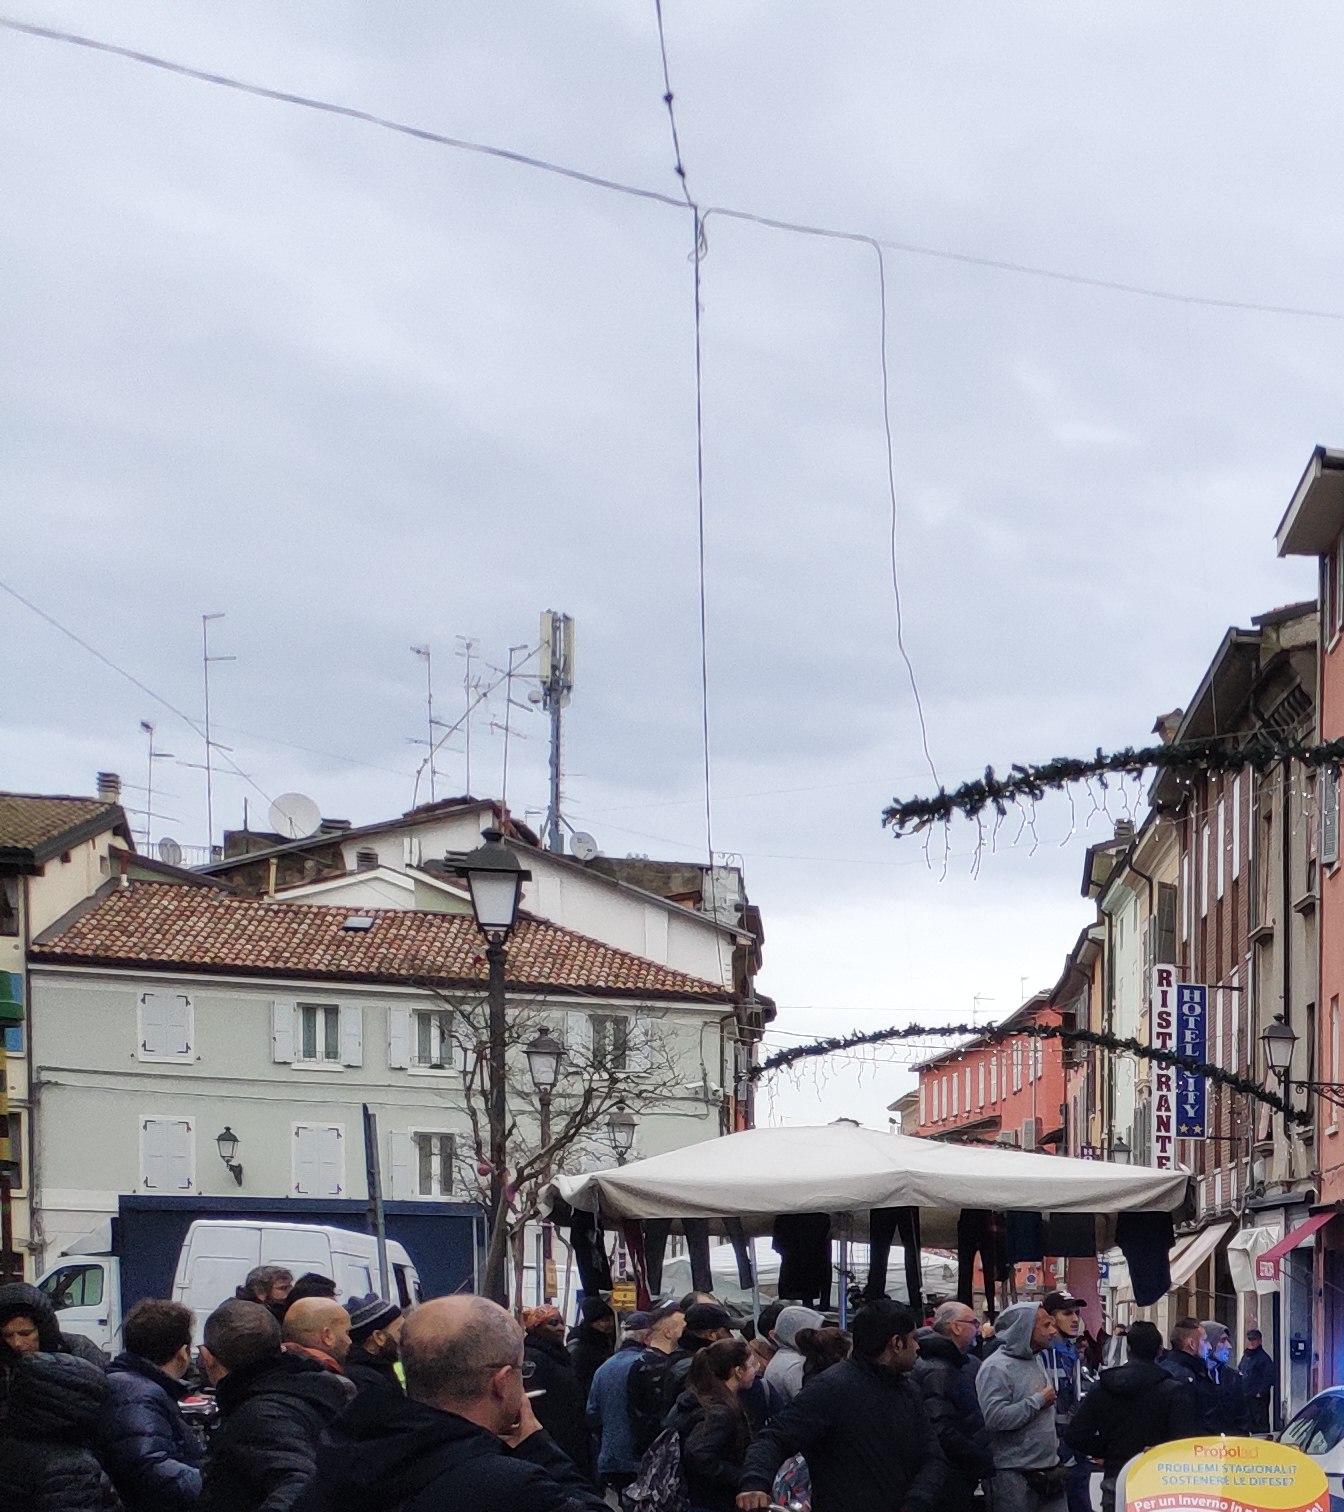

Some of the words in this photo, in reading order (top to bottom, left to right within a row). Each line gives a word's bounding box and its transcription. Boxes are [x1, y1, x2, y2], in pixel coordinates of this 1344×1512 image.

[1181, 989, 1201, 1056] HOTEL
[1157, 1462, 1218, 1473] PROBLEMI
[1161, 1475, 1230, 1486] SOSTENERE
[1233, 1477, 1248, 1486] LE
[1134, 1500, 1158, 1512] Per
[1162, 1497, 1176, 1507] un
